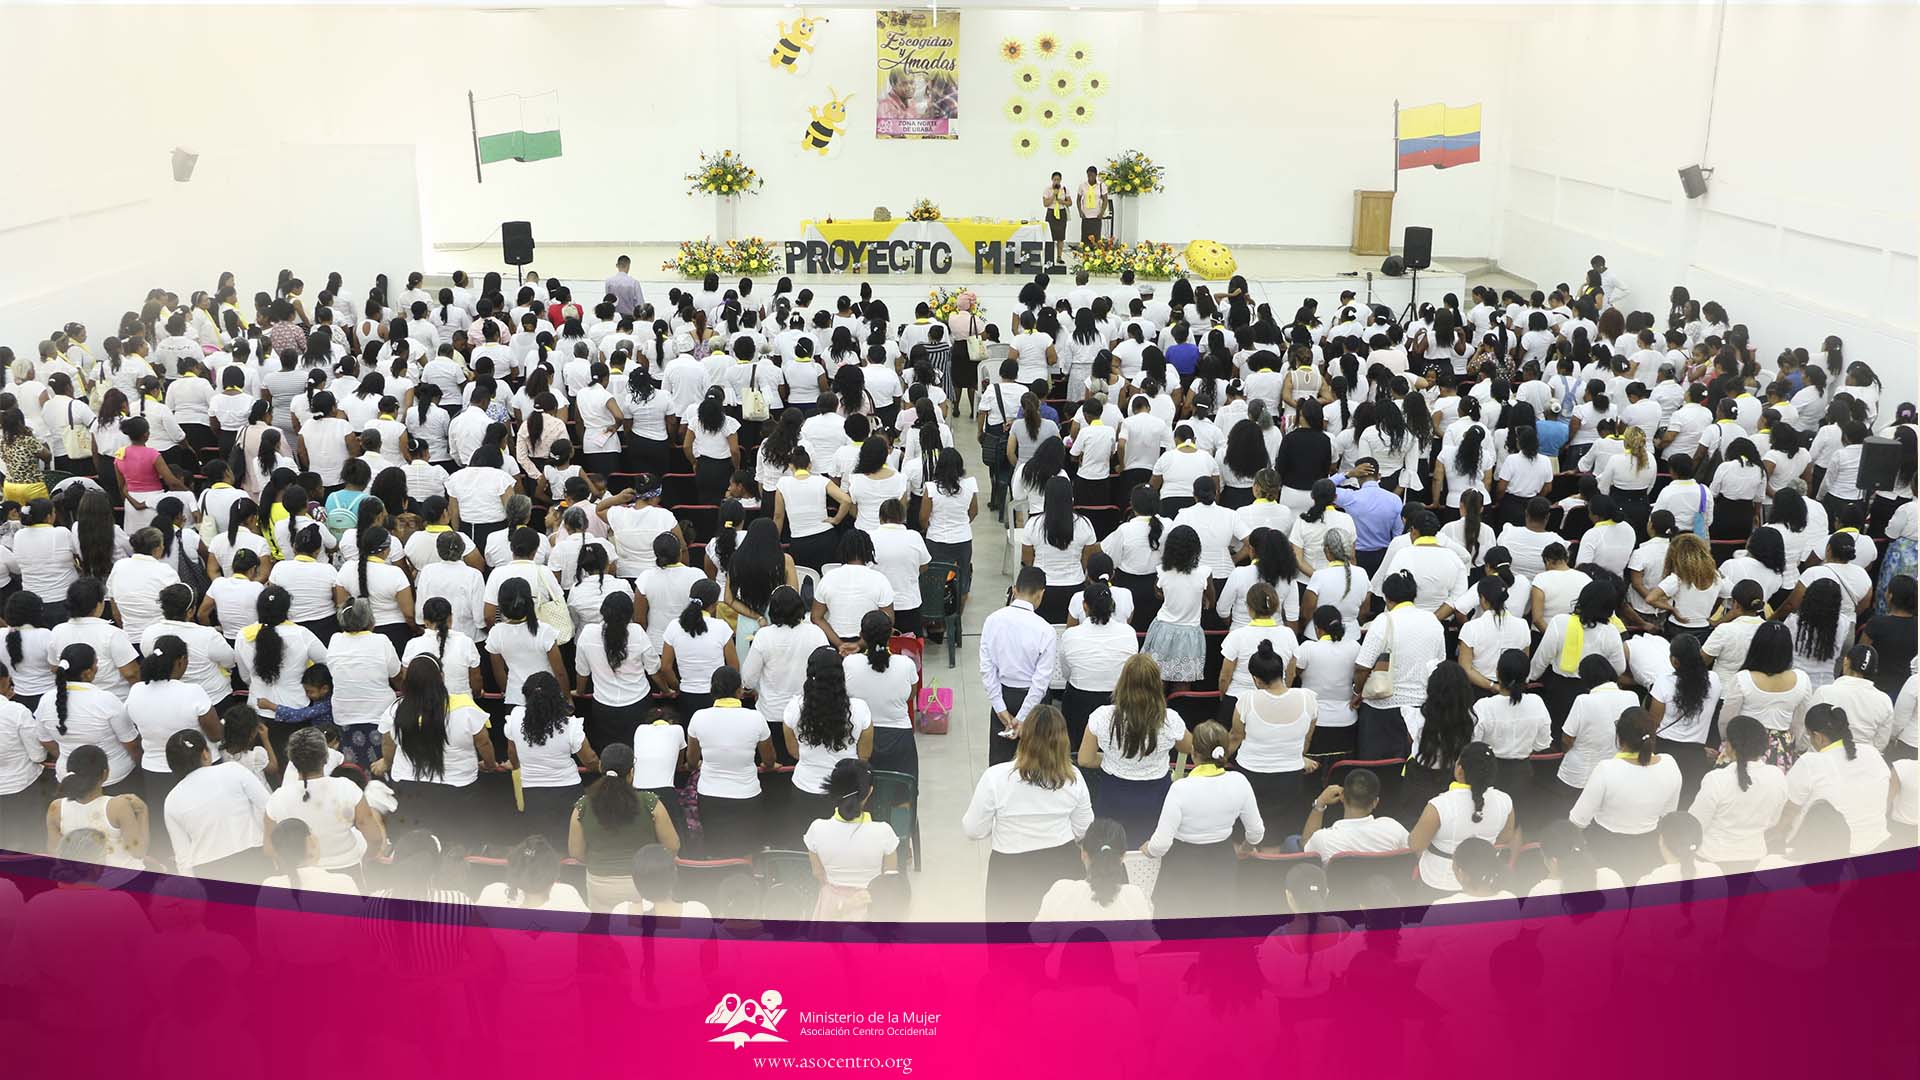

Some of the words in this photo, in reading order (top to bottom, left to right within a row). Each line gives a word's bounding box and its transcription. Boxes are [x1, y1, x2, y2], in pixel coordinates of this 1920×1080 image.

[880, 31, 953, 50] Escogidas
[878, 49, 957, 75] Amadas
[899, 48, 906, 57] y
[785, 240, 952, 274] PROYECTO
[974, 240, 1066, 274] MIEL
